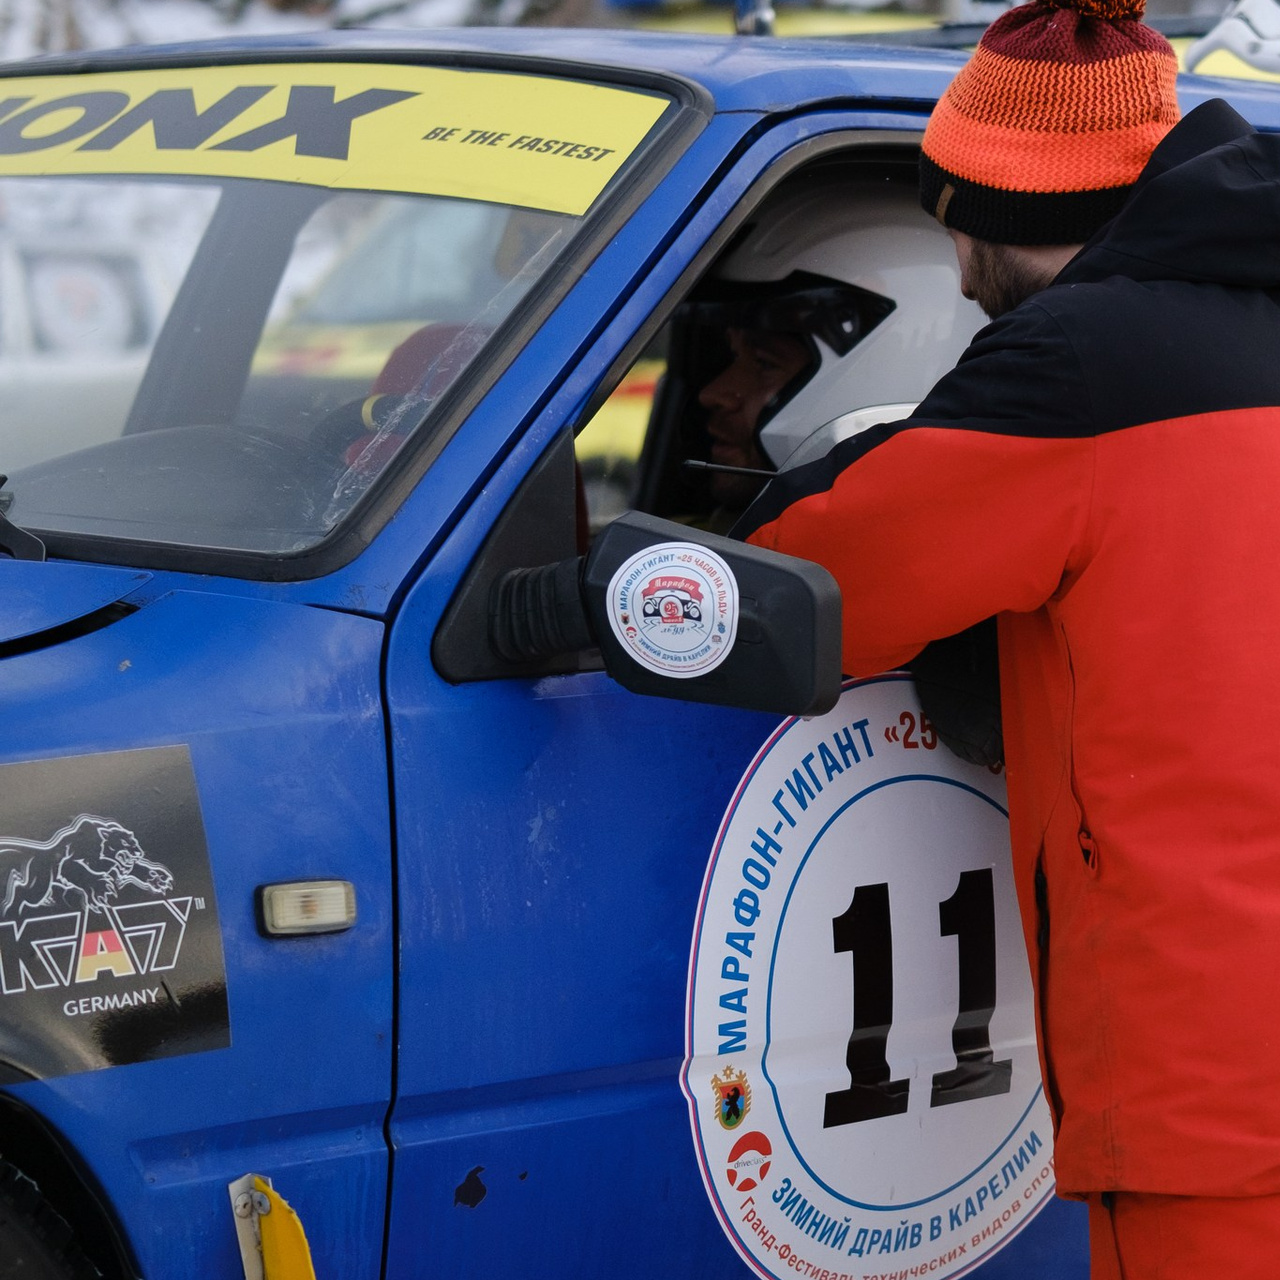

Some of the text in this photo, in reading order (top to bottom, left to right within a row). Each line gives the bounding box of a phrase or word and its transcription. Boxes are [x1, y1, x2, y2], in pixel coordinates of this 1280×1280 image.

[0, 85, 616, 162] ONX BE THE FASTEST
[620, 554, 675, 610] МАРАФОН-ГИГАНТ
[695, 559, 717, 577] ЧАСОВ
[714, 574, 724, 588] НА
[664, 602, 679, 615] 25
[717, 718, 875, 1056] МАРАФОН-ГИГАНТ
[62, 986, 160, 1017] GERMANY
[822, 867, 1012, 1129] 11
[771, 1130, 1043, 1258] ЗИМНИЙ ДРАЙВ В КАРЕЛИИ
[971, 1200, 1022, 1248] видов
